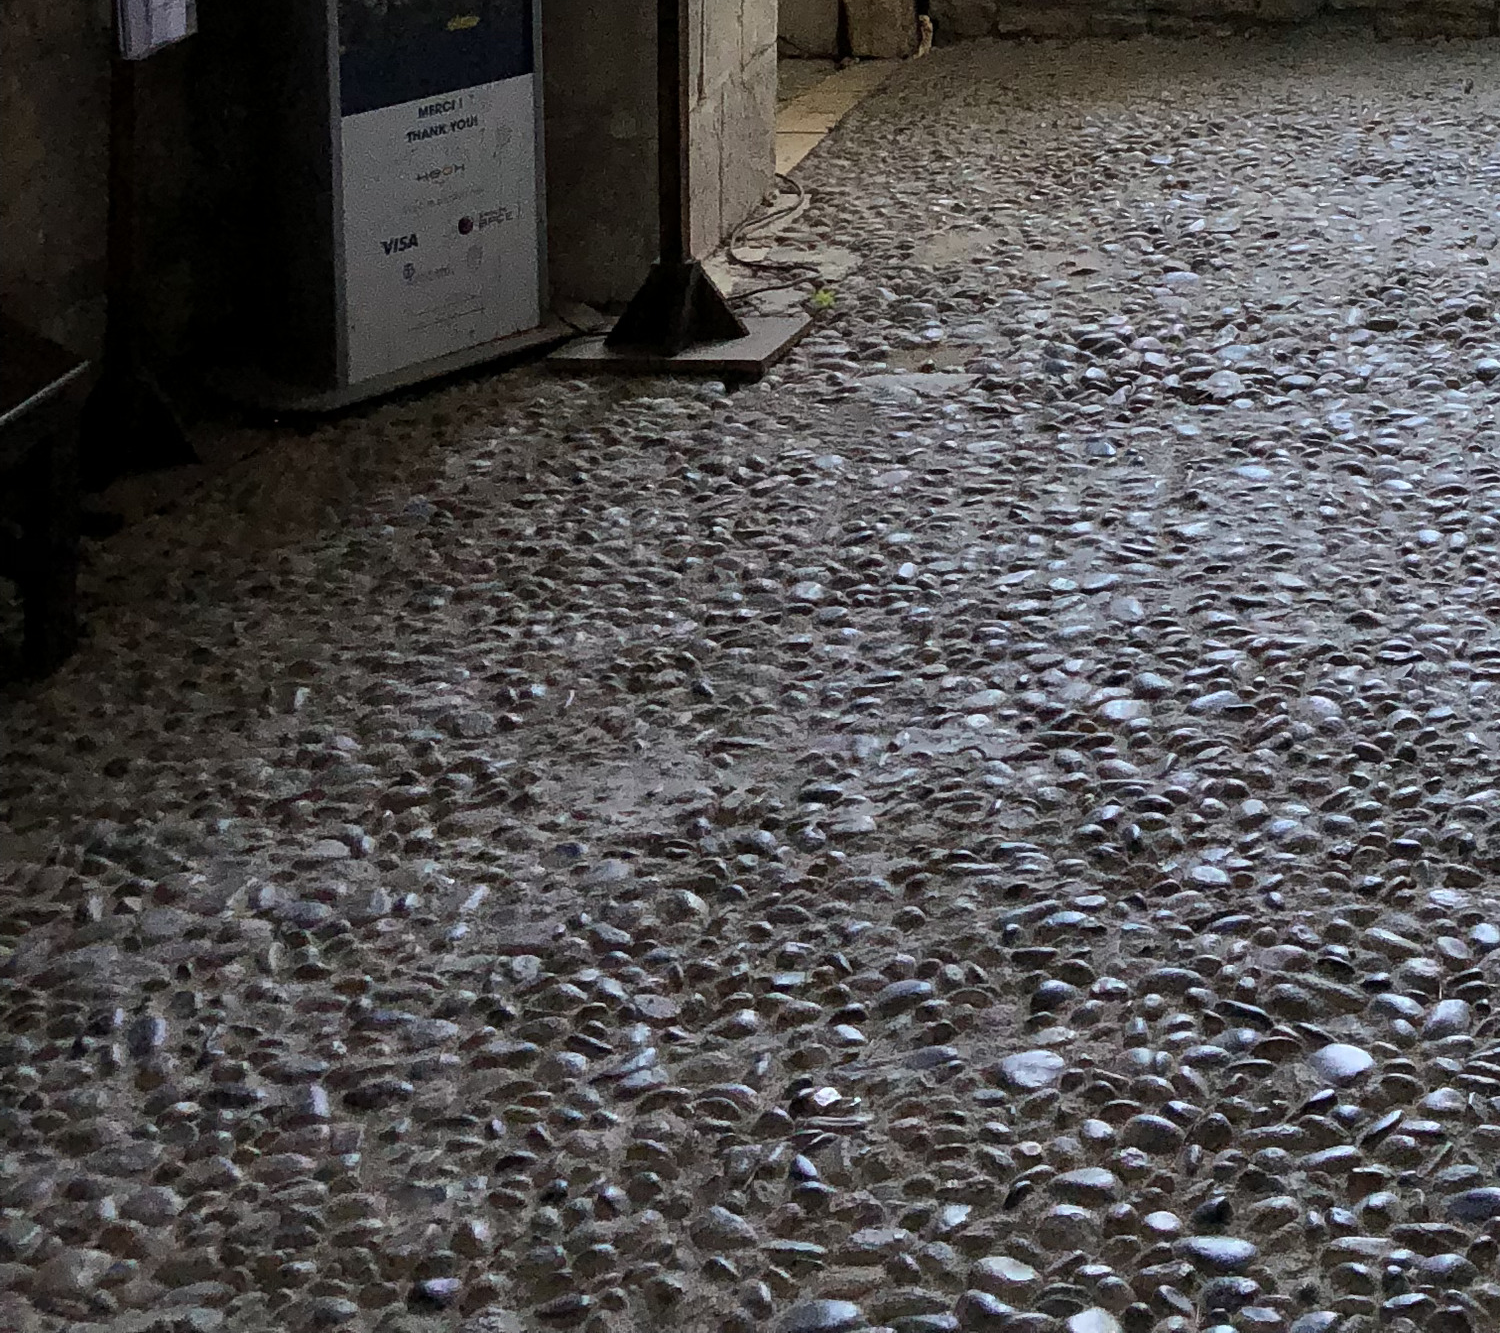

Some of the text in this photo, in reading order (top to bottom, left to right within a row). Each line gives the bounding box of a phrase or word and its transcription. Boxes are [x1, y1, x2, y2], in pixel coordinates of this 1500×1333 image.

[418, 99, 455, 118] MERCI
[406, 114, 478, 142] THANK YOU!
[380, 233, 418, 255] VISA
